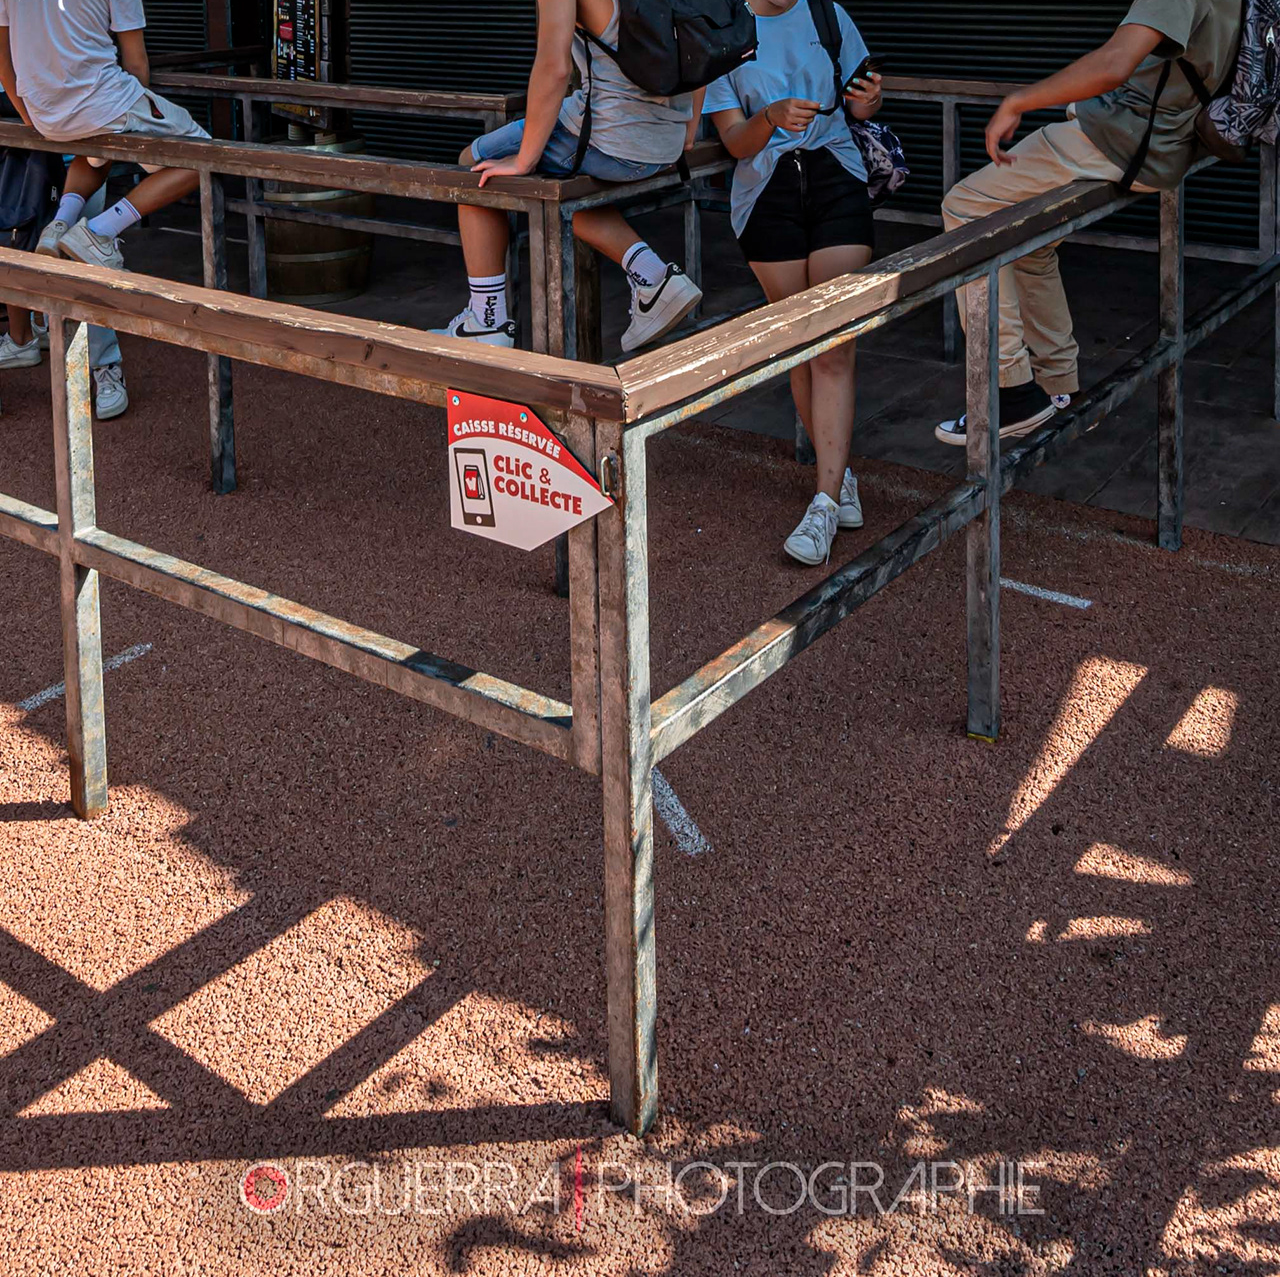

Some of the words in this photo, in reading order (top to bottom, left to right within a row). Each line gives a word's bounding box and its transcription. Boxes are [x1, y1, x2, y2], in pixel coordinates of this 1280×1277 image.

[498, 421, 561, 459] RÉSERVÉE
[493, 475, 583, 516] COLLECTE
[539, 467, 552, 486] &
